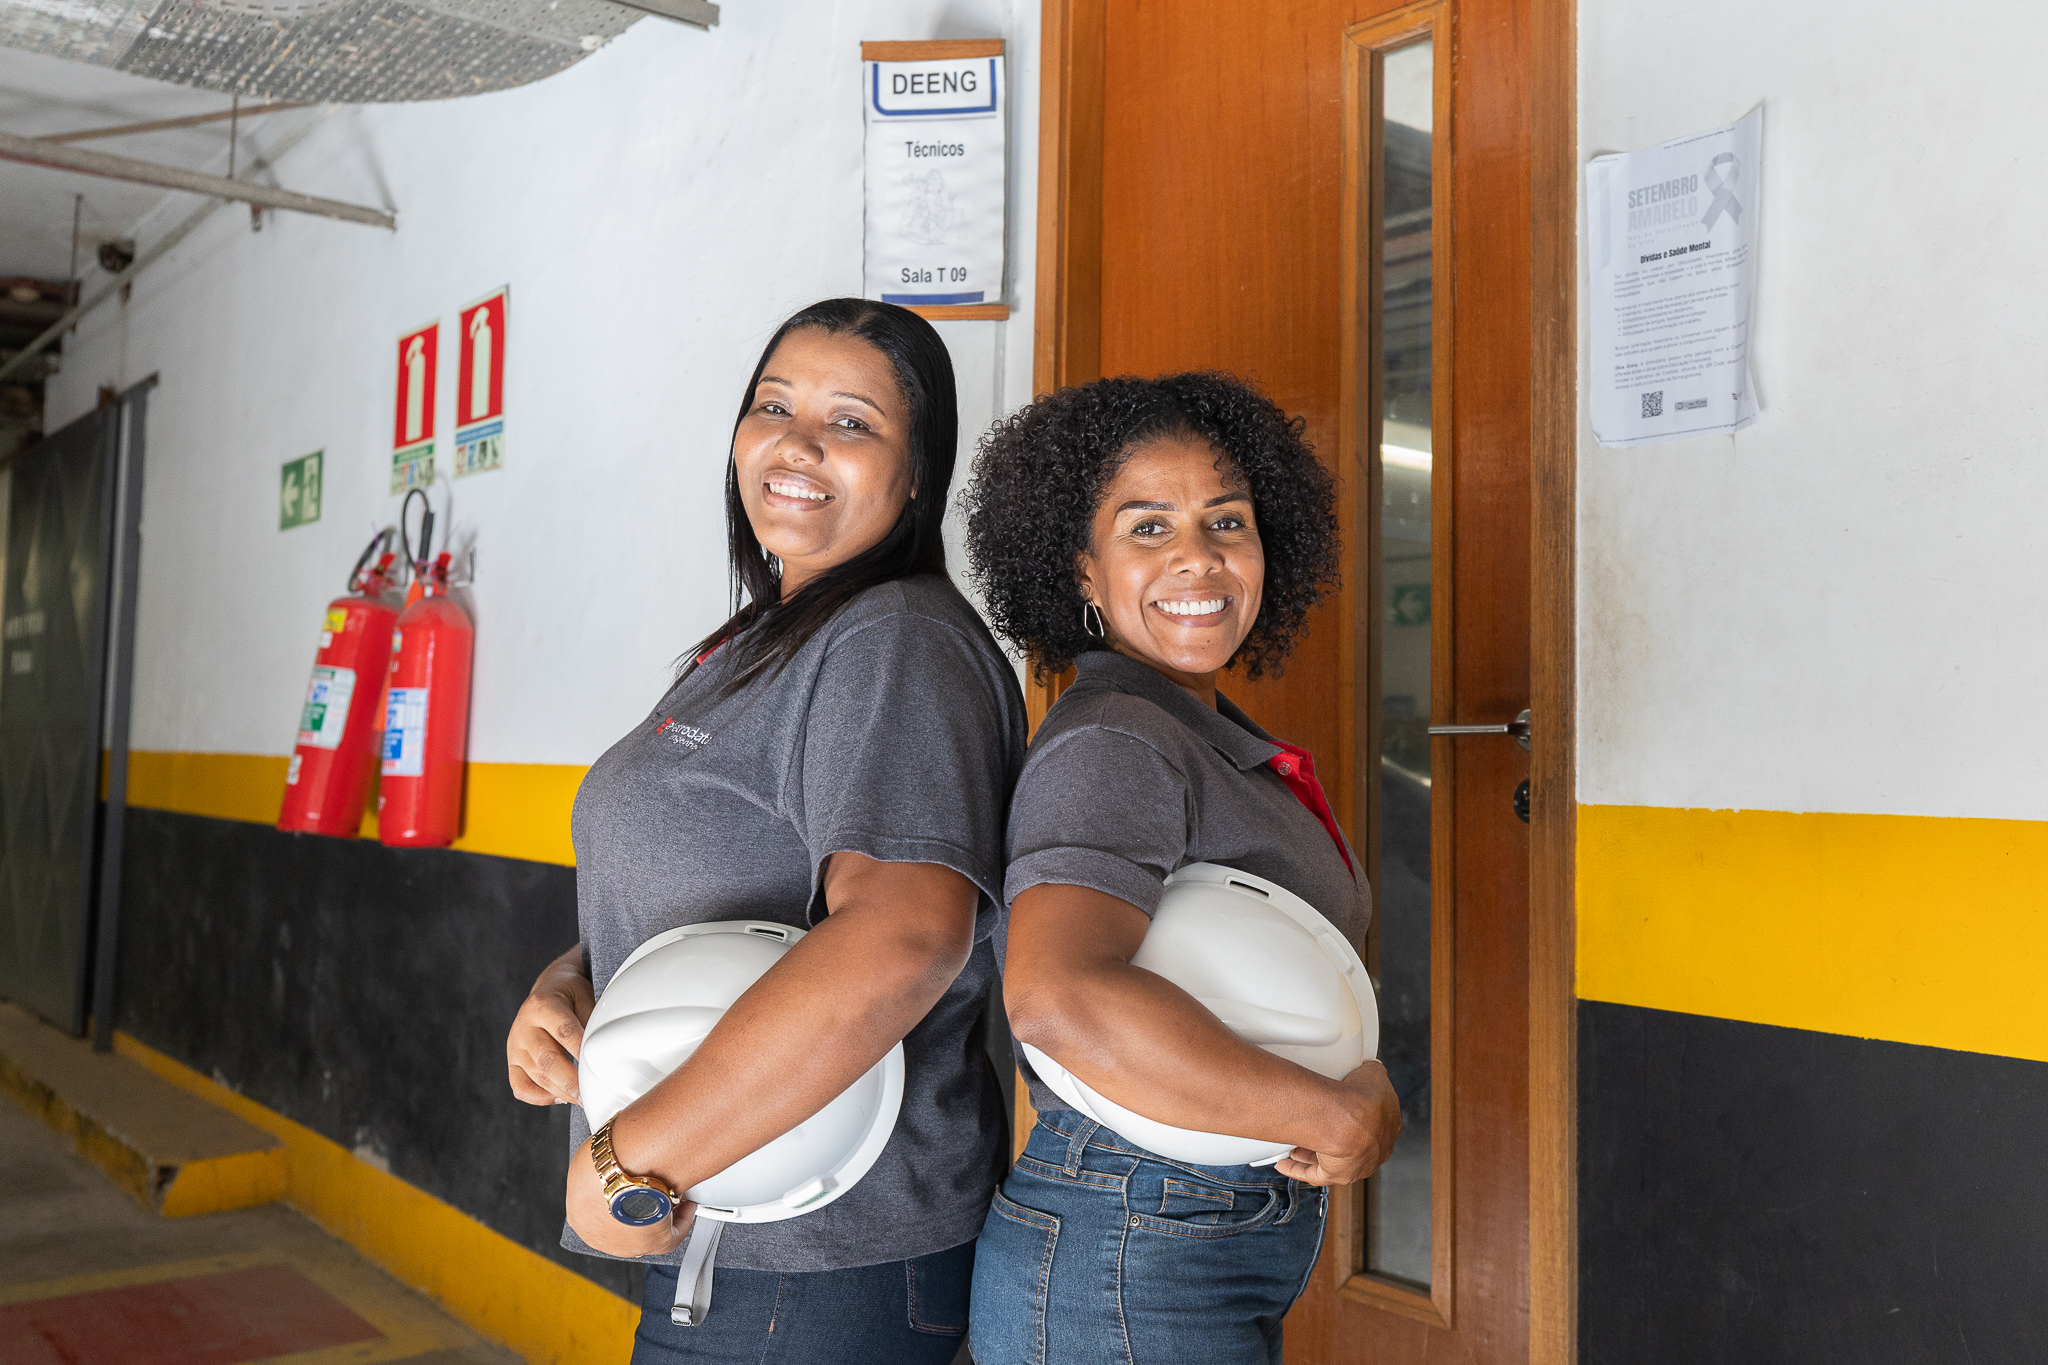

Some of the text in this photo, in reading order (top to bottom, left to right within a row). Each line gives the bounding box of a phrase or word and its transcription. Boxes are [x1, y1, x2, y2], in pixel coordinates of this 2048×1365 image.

[893, 71, 977, 94] DEENG
[905, 140, 964, 158] Técnicos
[1628, 174, 1698, 209] SETEMBRO
[1628, 195, 1698, 232] AMARELO
[1640, 240, 1711, 264] Dívidas e Saúde Mental
[901, 266, 967, 283] Sala T 09
